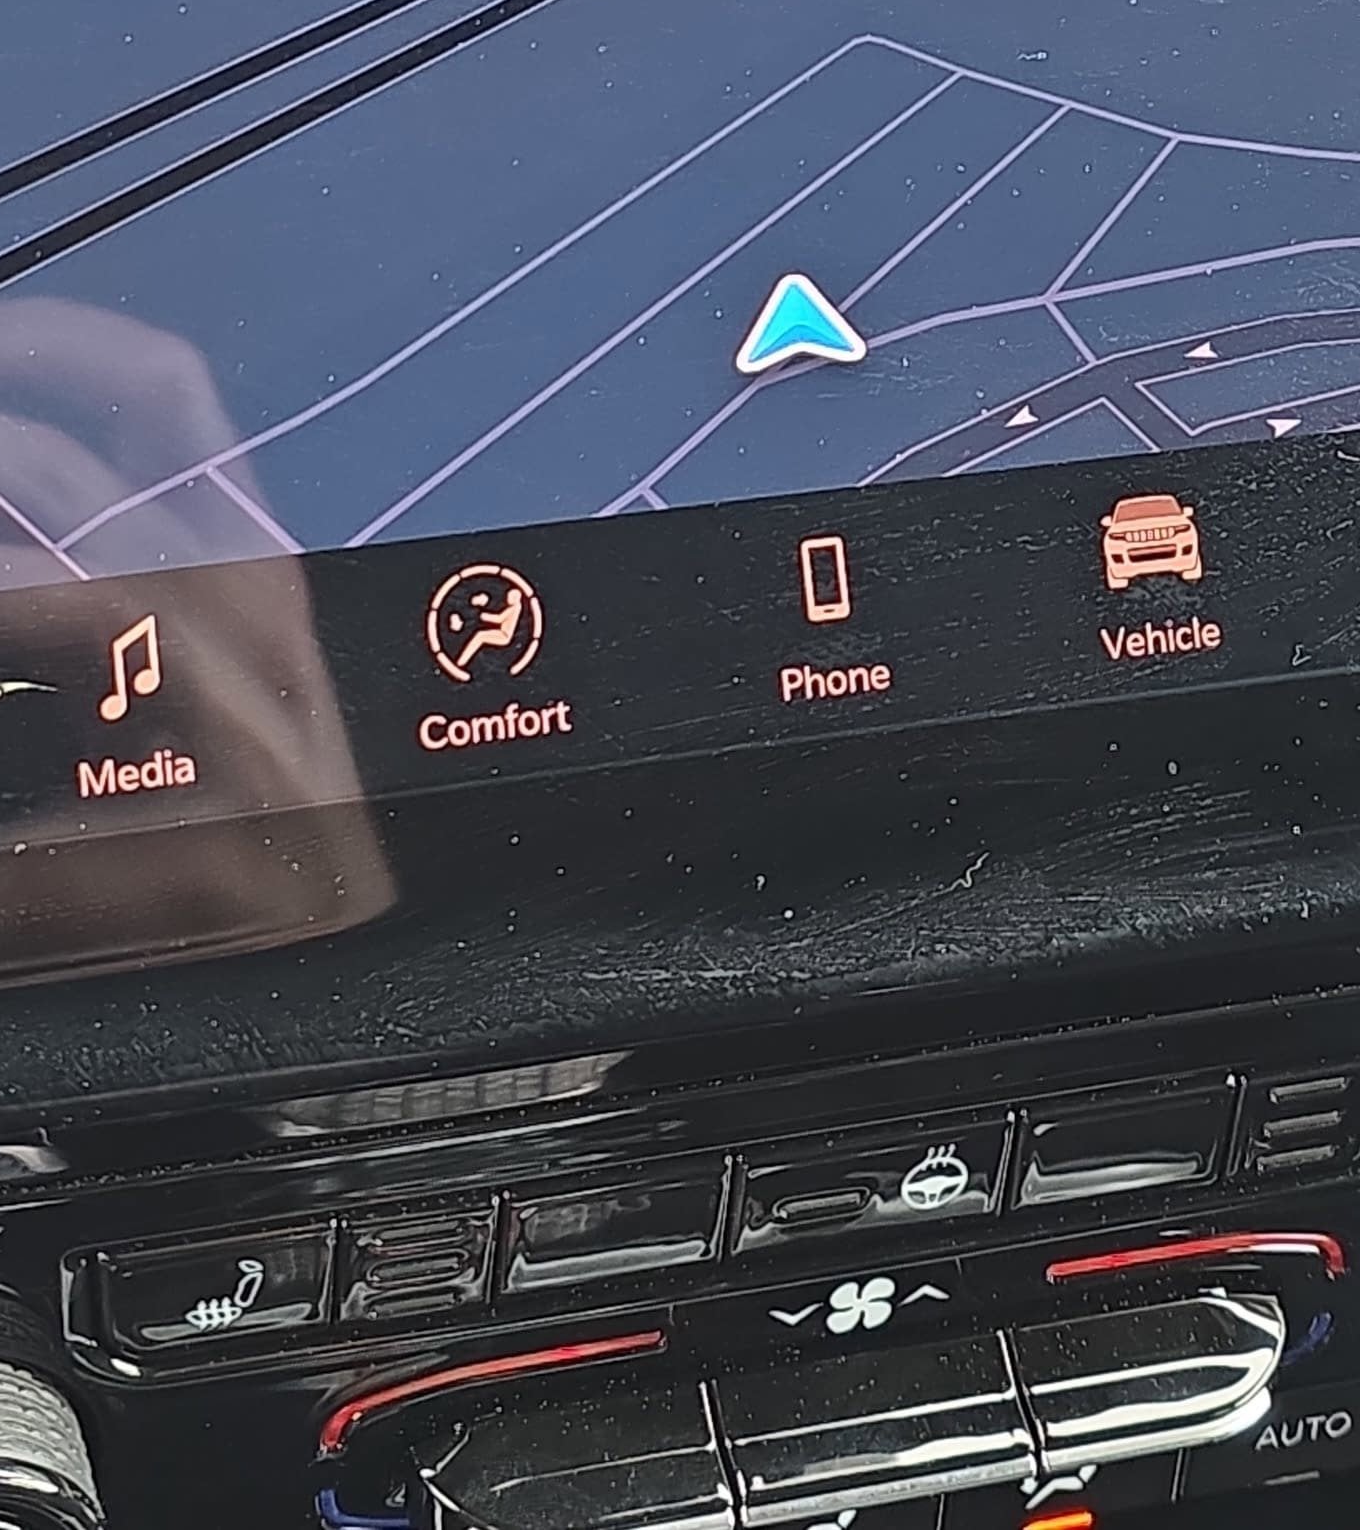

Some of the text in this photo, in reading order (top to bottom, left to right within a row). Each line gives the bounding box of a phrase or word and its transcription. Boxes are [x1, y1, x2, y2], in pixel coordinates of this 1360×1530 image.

[1099, 616, 1222, 660] Vehicle
[780, 663, 891, 703] Phone
[418, 699, 573, 751] Comfort
[77, 749, 197, 799] Media
[1255, 1411, 1353, 1452] AUTO
